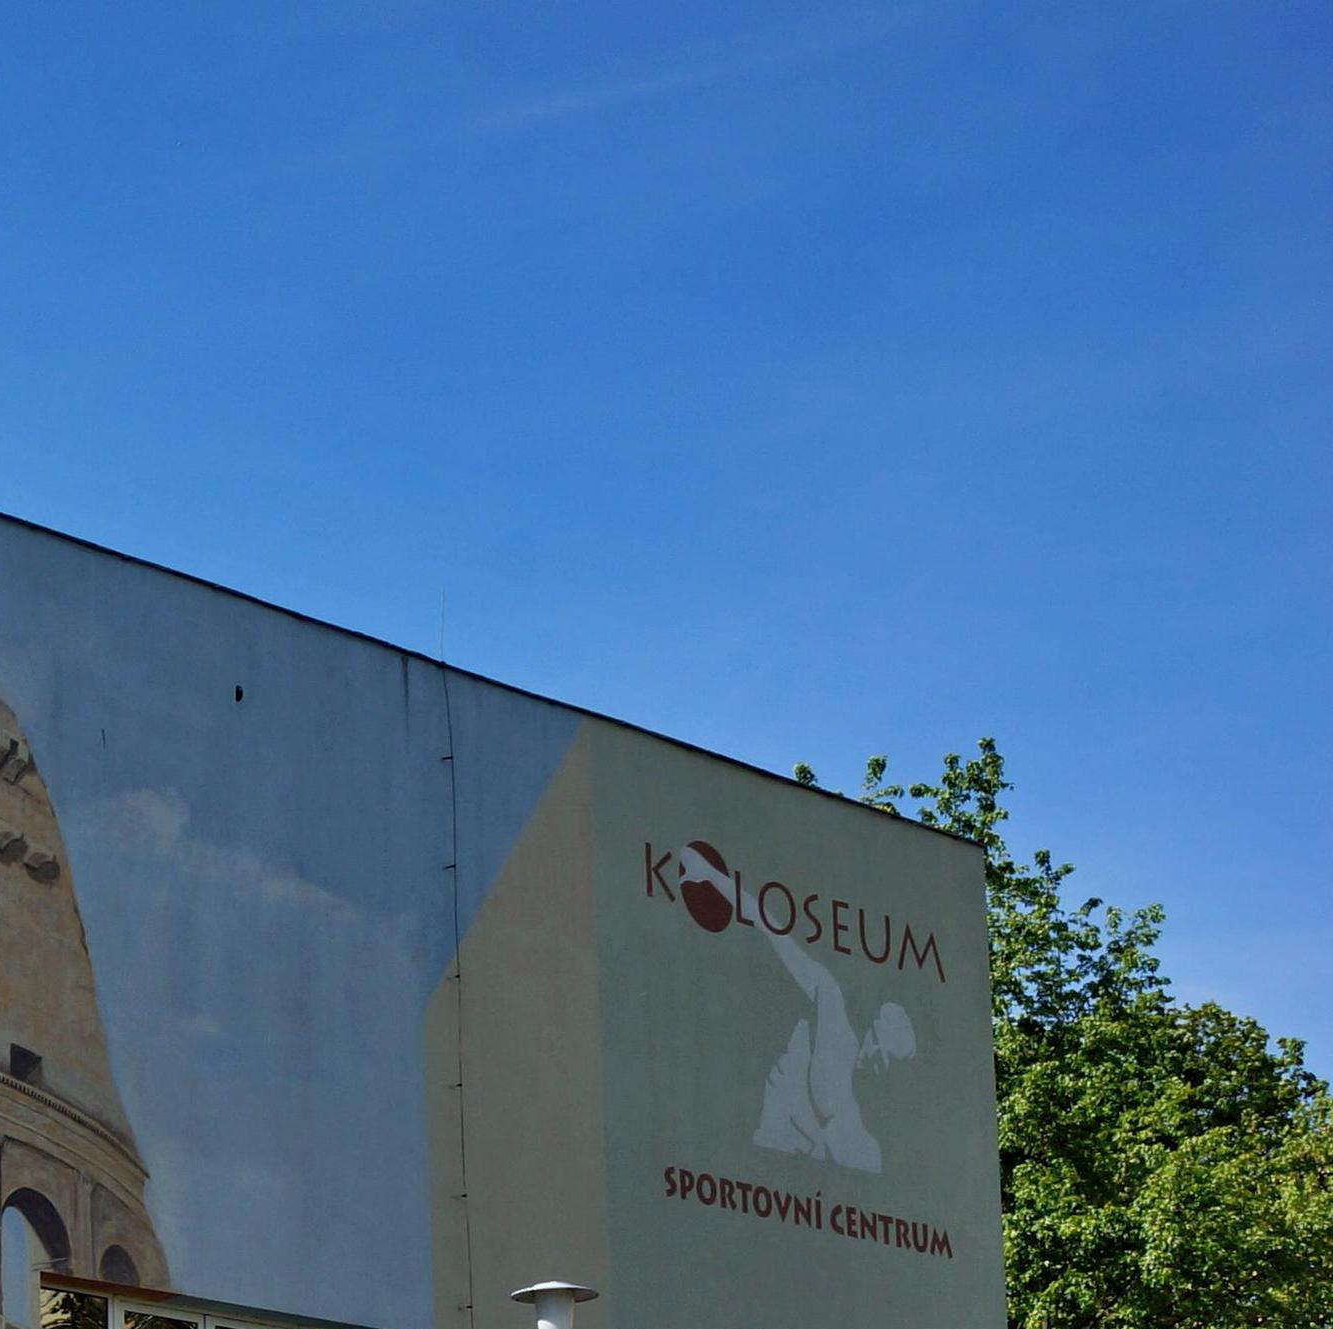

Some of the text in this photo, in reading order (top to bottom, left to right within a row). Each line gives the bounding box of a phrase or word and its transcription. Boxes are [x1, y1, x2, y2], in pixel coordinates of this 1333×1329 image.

[644, 840, 946, 983] KOLOSEUM
[664, 1166, 953, 1258] SPORTOVNÍ CENTRUM
